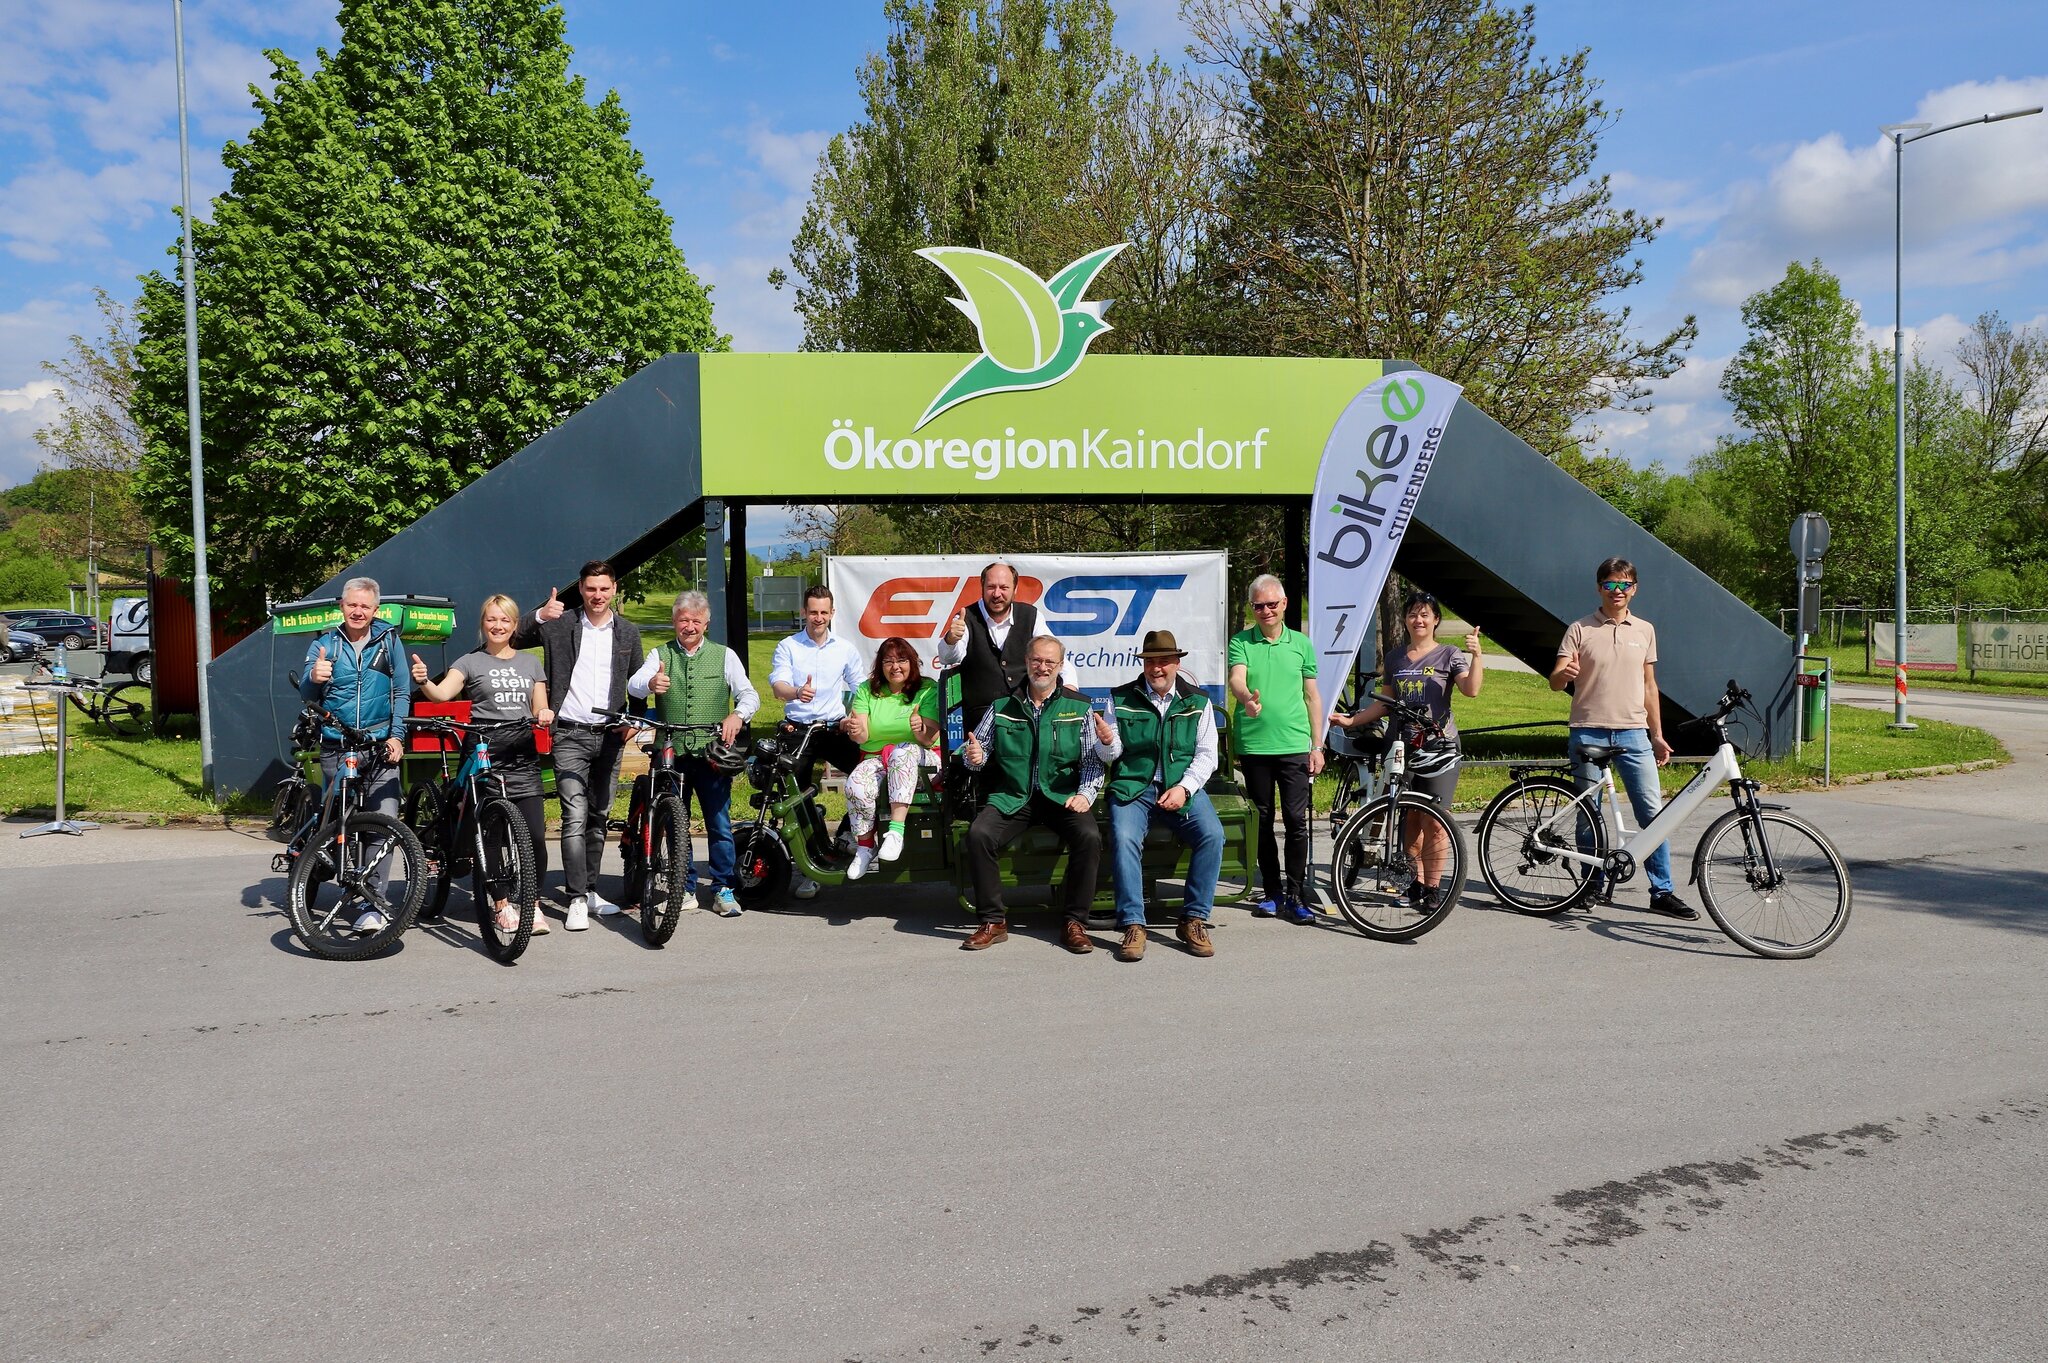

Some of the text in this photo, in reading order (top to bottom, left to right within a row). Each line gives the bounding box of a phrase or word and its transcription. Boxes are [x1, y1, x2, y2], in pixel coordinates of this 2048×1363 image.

[1387, 426, 1442, 541] STUBENBERG
[282, 616, 296, 627] Ich
[488, 666, 518, 677] ost
[491, 676, 531, 688] steir
[494, 688, 526, 703] arin
